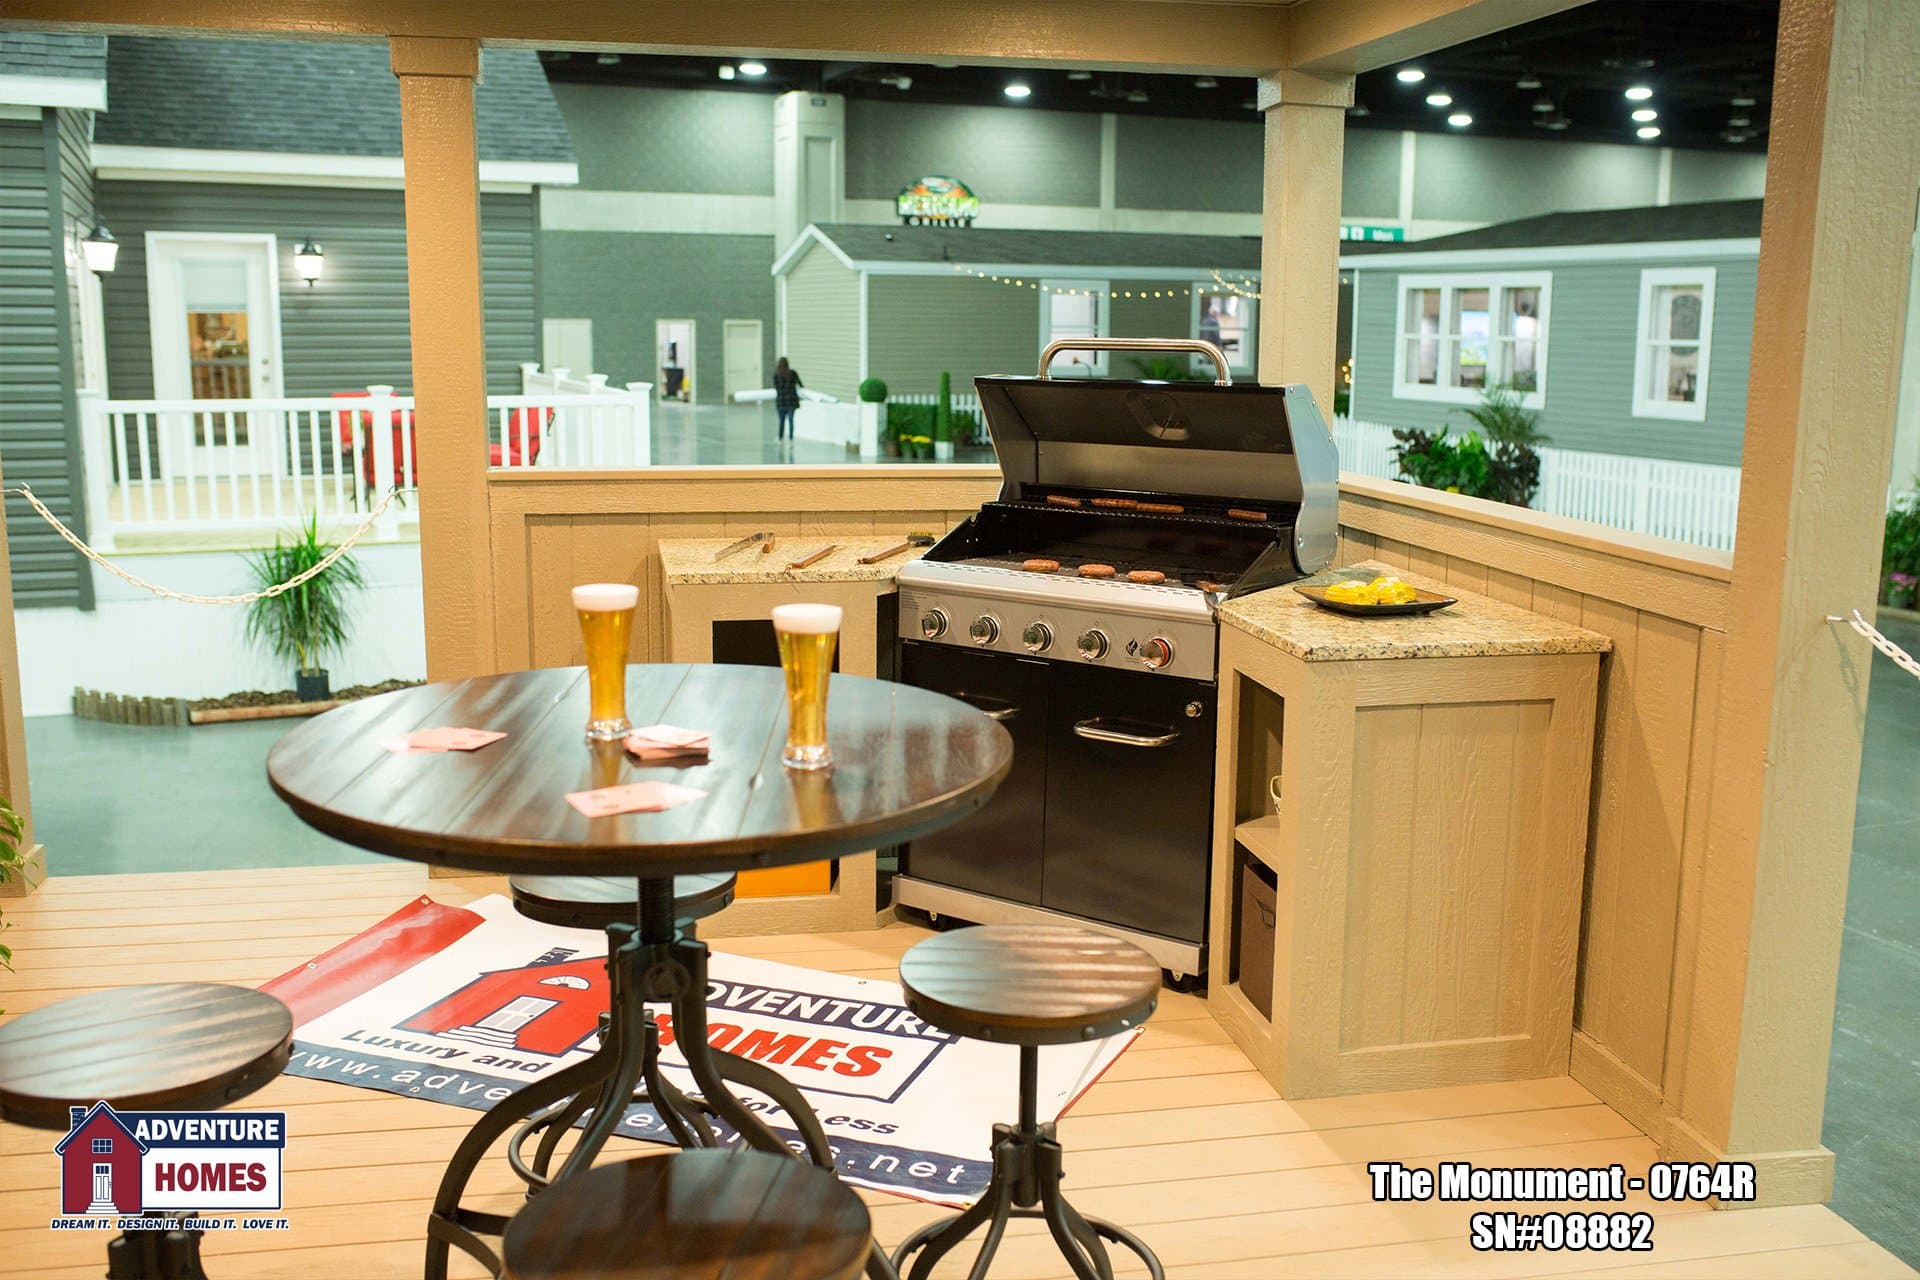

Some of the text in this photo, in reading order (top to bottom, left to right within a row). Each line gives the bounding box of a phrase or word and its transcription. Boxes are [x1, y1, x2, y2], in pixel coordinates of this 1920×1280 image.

[706, 980, 951, 1040] DVENTUR
[341, 1029, 469, 1059] Luxury
[472, 1053, 552, 1073] and
[811, 1109, 899, 1134] ess
